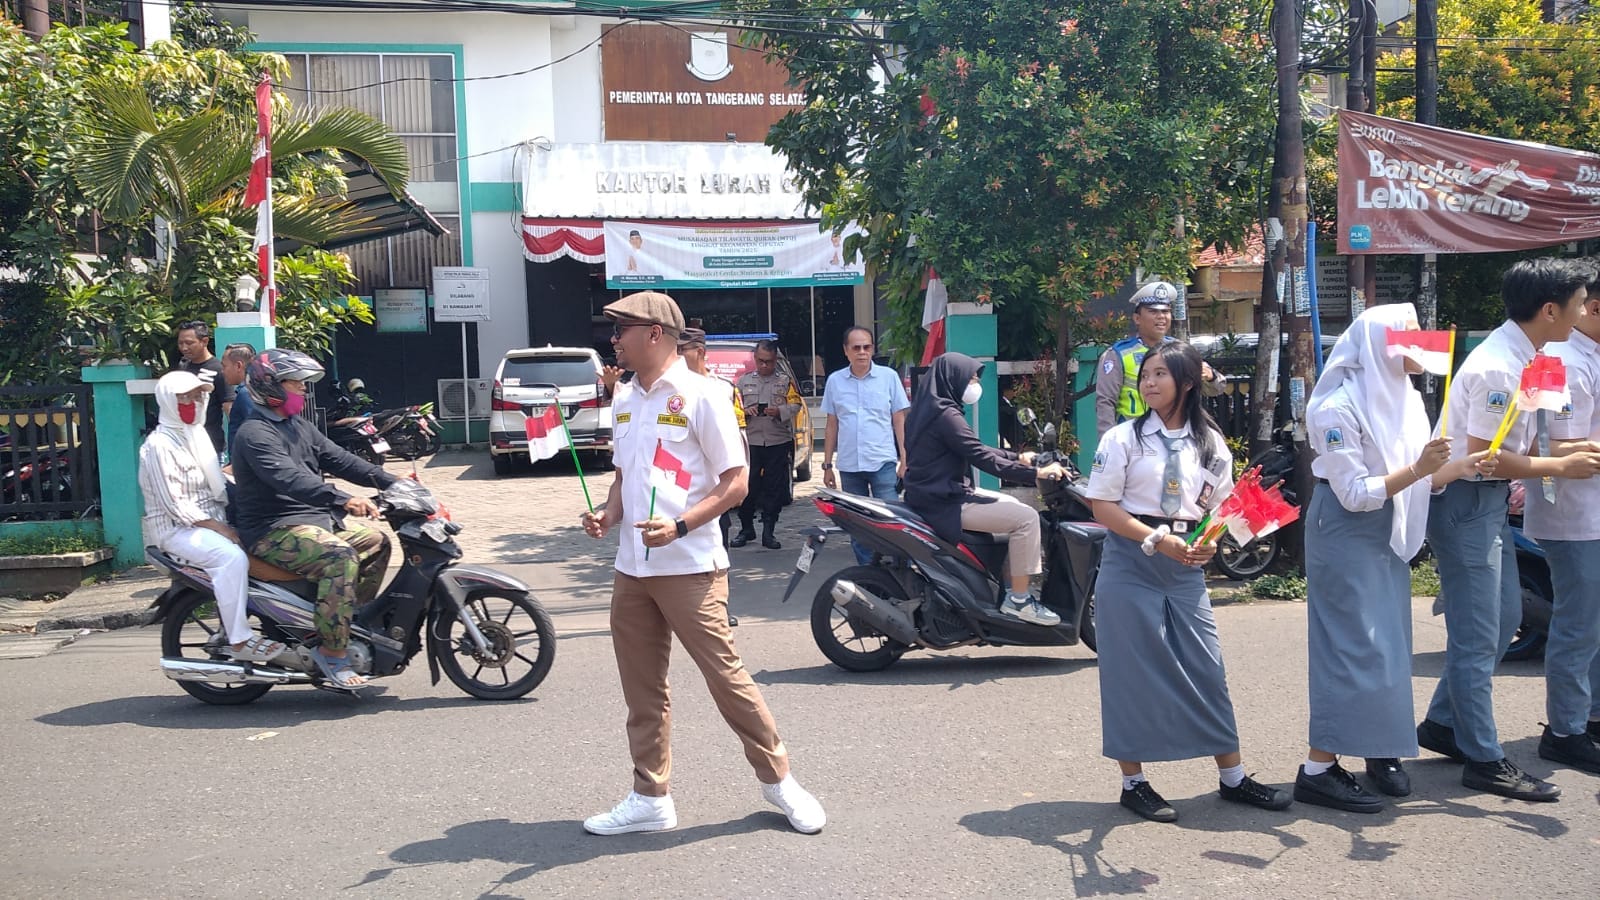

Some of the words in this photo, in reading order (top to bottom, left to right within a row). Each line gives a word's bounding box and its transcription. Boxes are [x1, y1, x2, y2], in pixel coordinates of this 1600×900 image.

[609, 91, 673, 104] PEMERINTAH
[676, 92, 703, 105] KOTA
[705, 92, 765, 106] TANGERANG
[596, 171, 688, 194] KANTOR
[700, 172, 771, 195] LURAH
[1368, 150, 1473, 189] Bangkit
[1576, 164, 1600, 183] Di
[1357, 180, 1429, 210] Lebih
[1434, 184, 1531, 223] Terang
